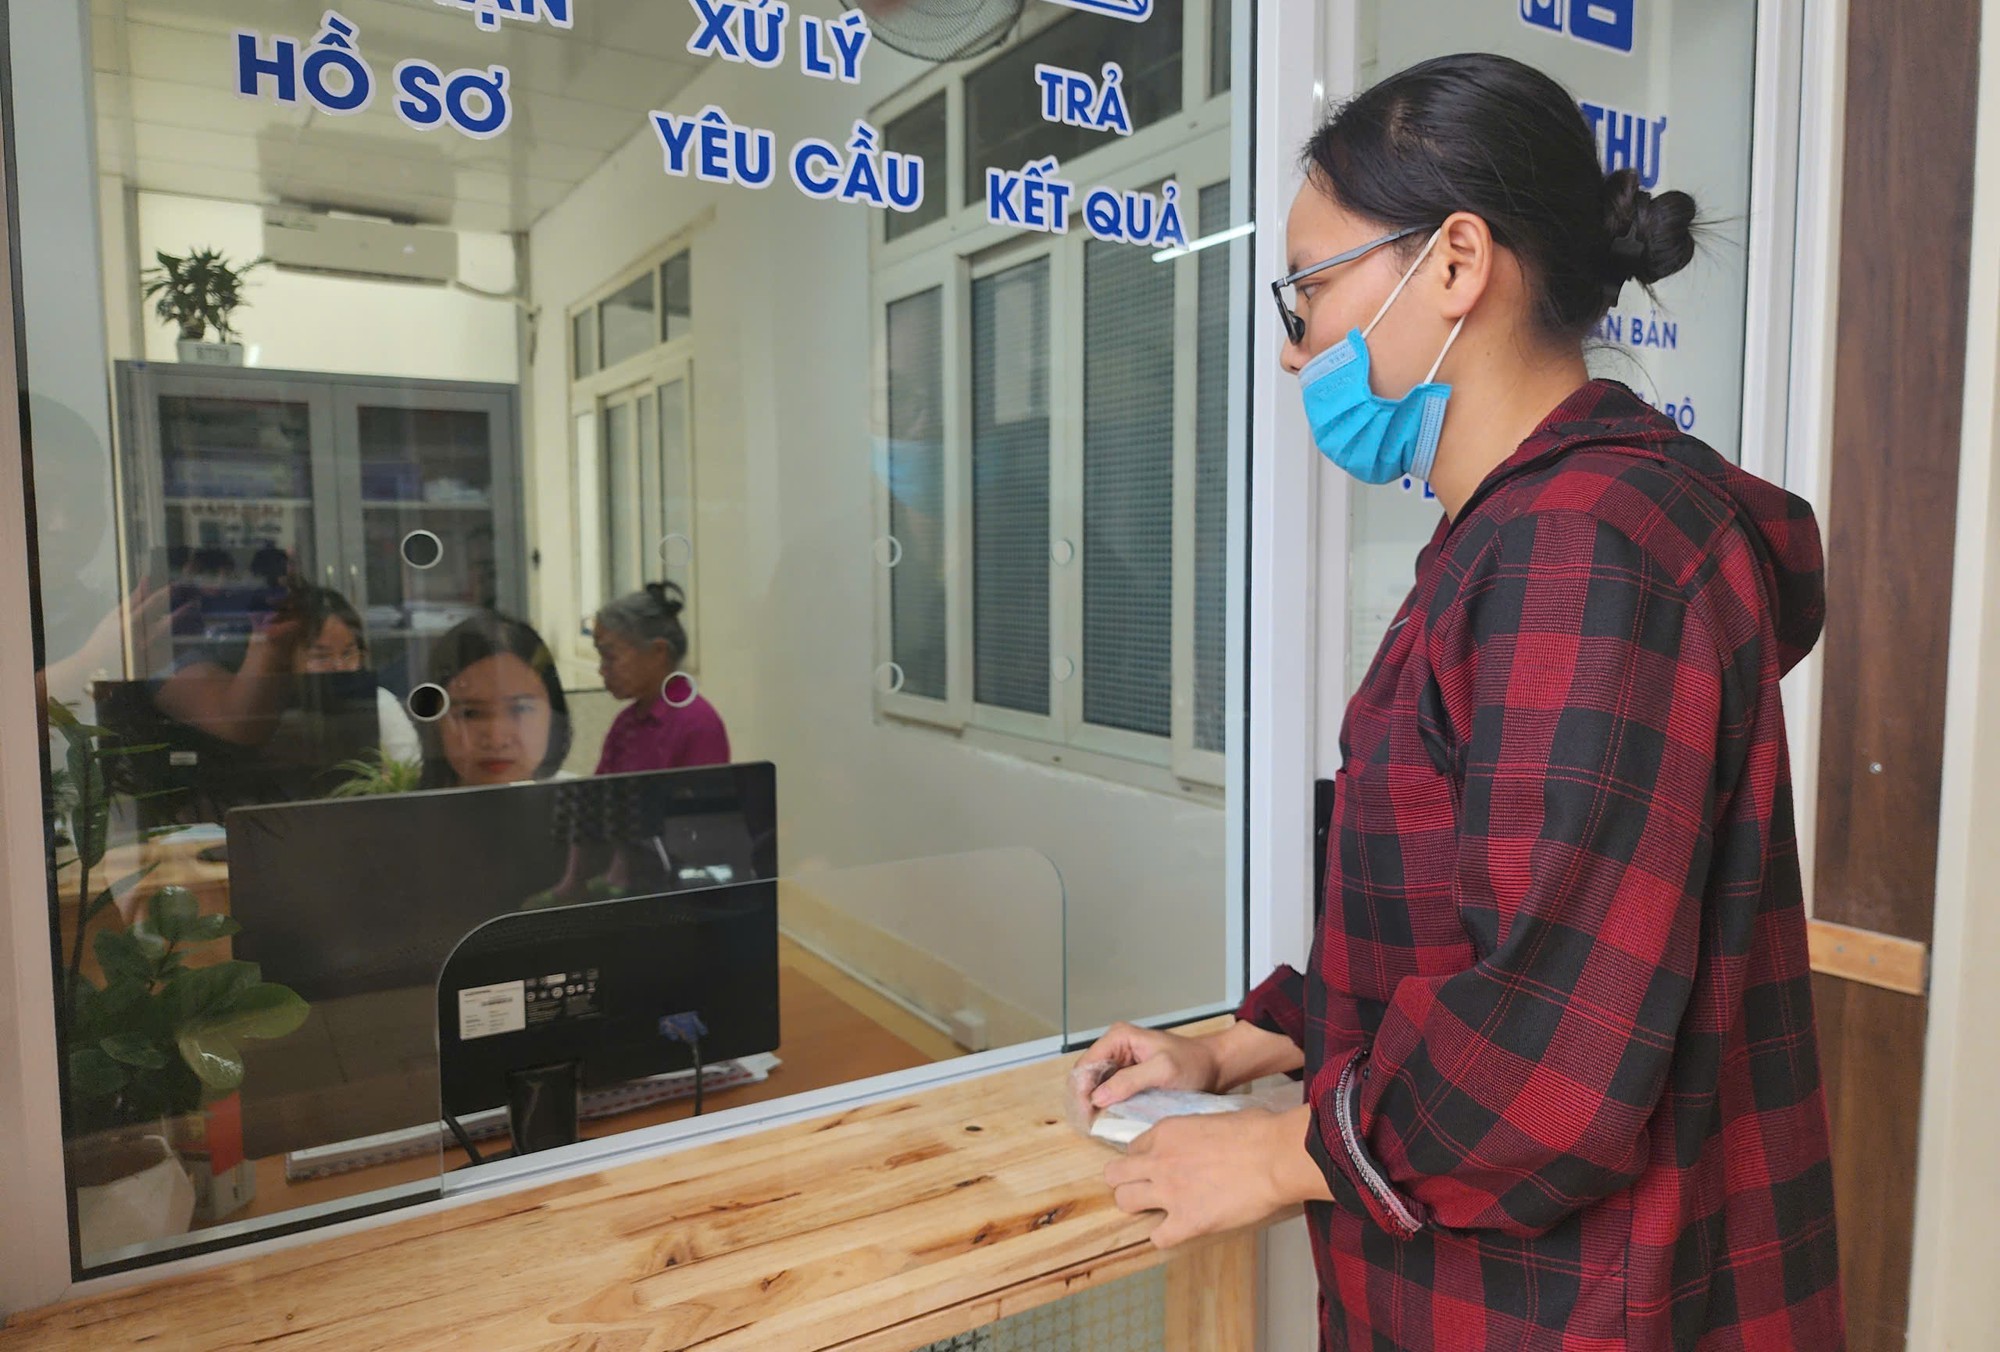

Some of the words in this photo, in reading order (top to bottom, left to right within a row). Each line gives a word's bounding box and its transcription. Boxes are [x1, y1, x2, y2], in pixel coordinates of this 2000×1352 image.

[238, 16, 370, 110] HỒ
[400, 65, 506, 133] SƠ
[805, 15, 867, 79] LÝ
[1040, 68, 1129, 131] TRẢ
[655, 111, 771, 184] YÊU
[794, 125, 920, 207] CẦU
[990, 161, 1071, 230] KẾT
[1085, 186, 1188, 246] QUẢ
[1631, 308, 1677, 349] BẢN
